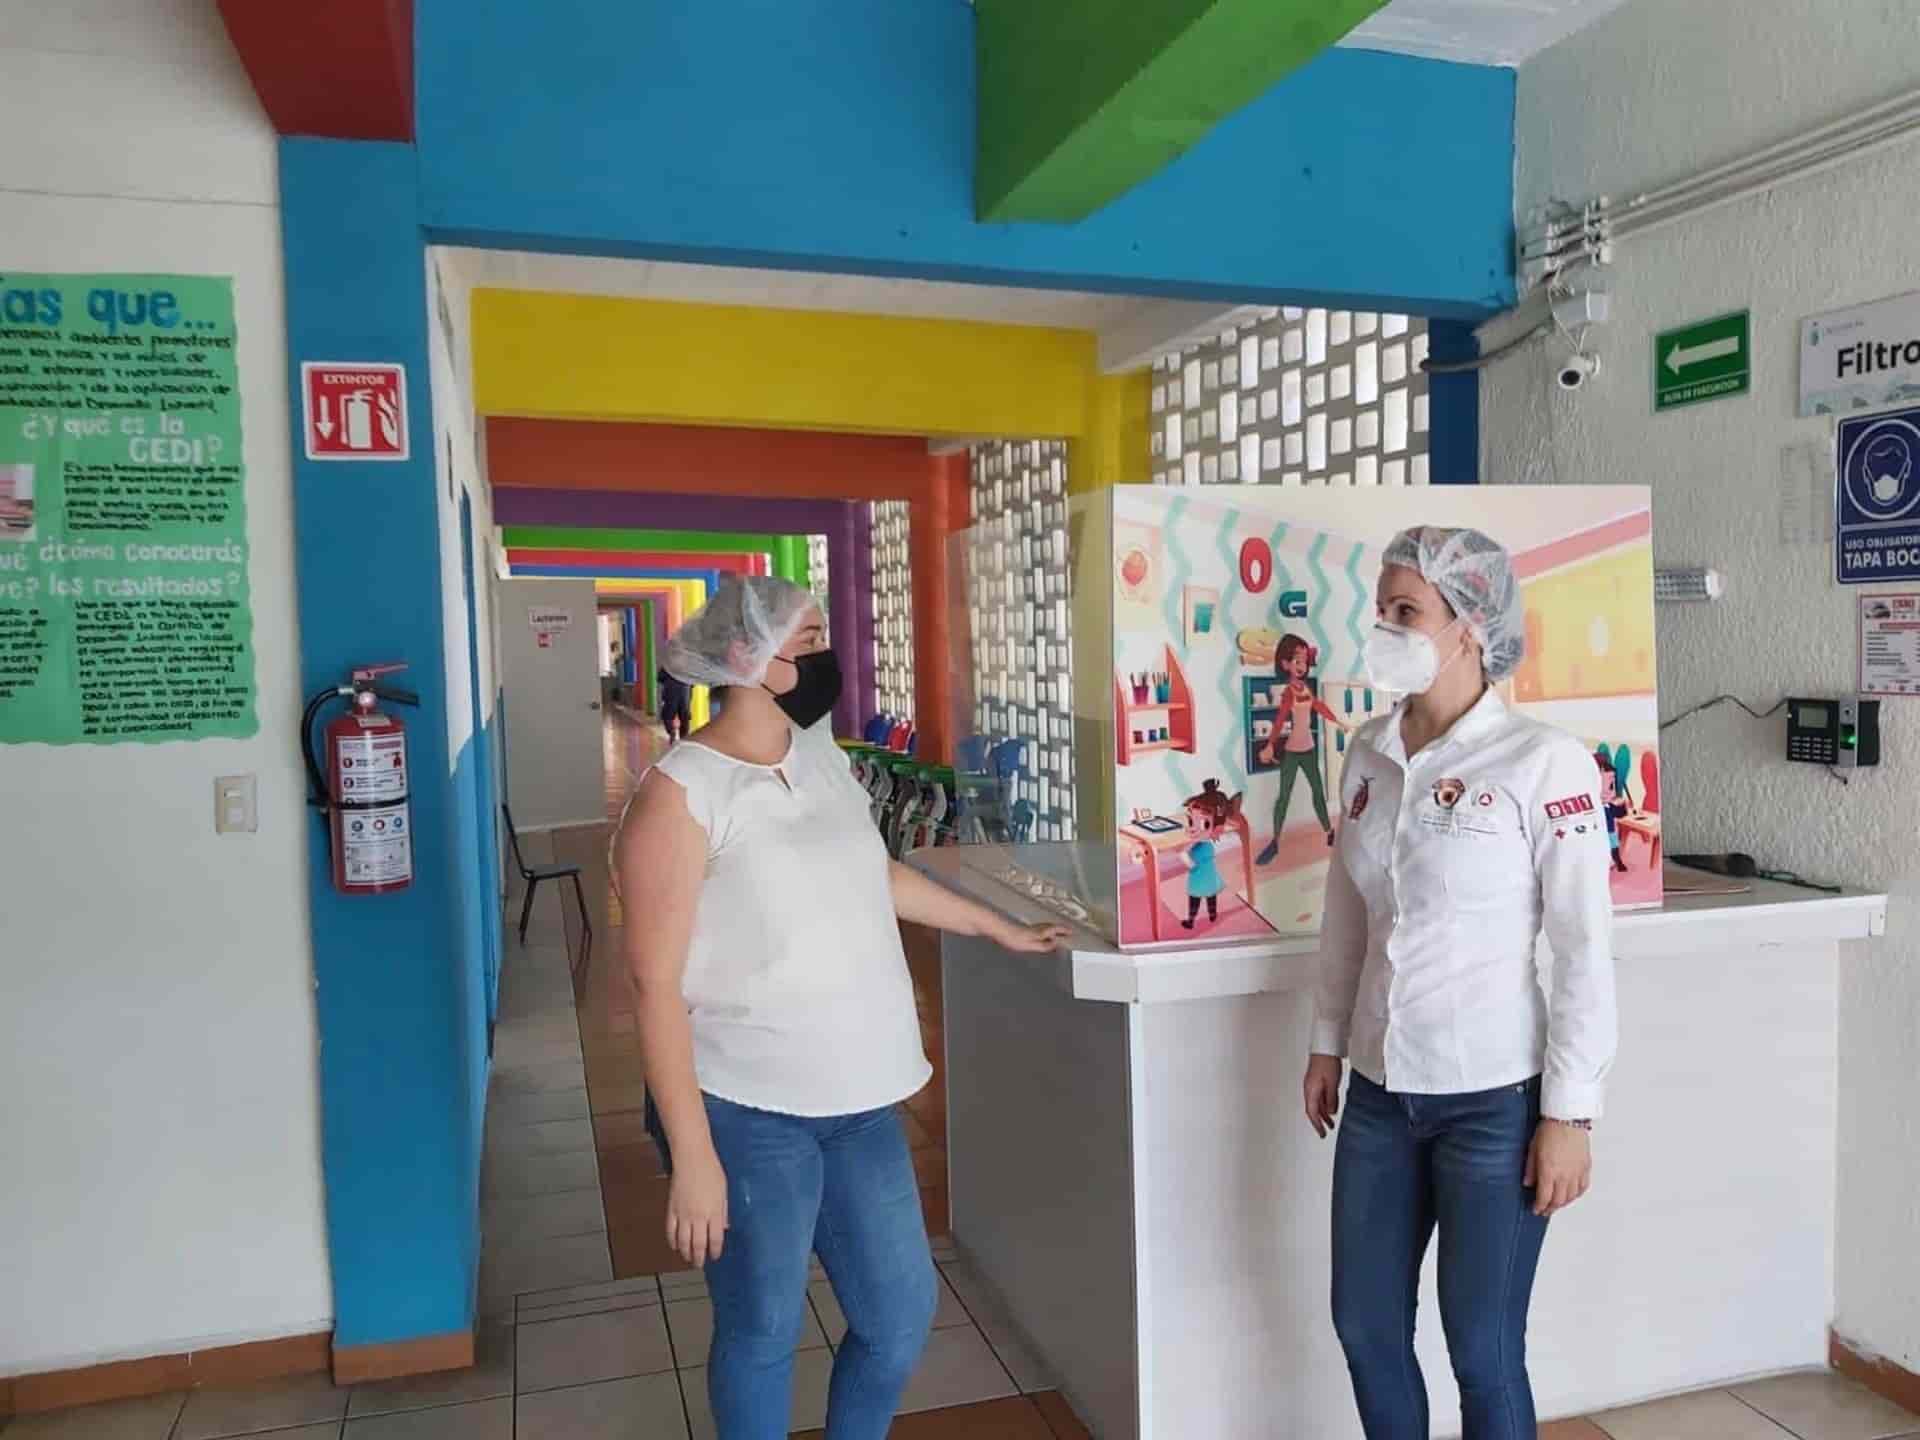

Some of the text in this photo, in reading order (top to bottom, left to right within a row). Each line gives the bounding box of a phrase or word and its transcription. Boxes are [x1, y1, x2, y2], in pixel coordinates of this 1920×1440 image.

[86, 287, 215, 336] que...
[1837, 341, 1920, 378] Filtro
[323, 374, 385, 385] EXTINTOR
[129, 434, 223, 465] CEDI?
[1845, 551, 1881, 569] TAPA
[1547, 796, 1592, 817] 911
